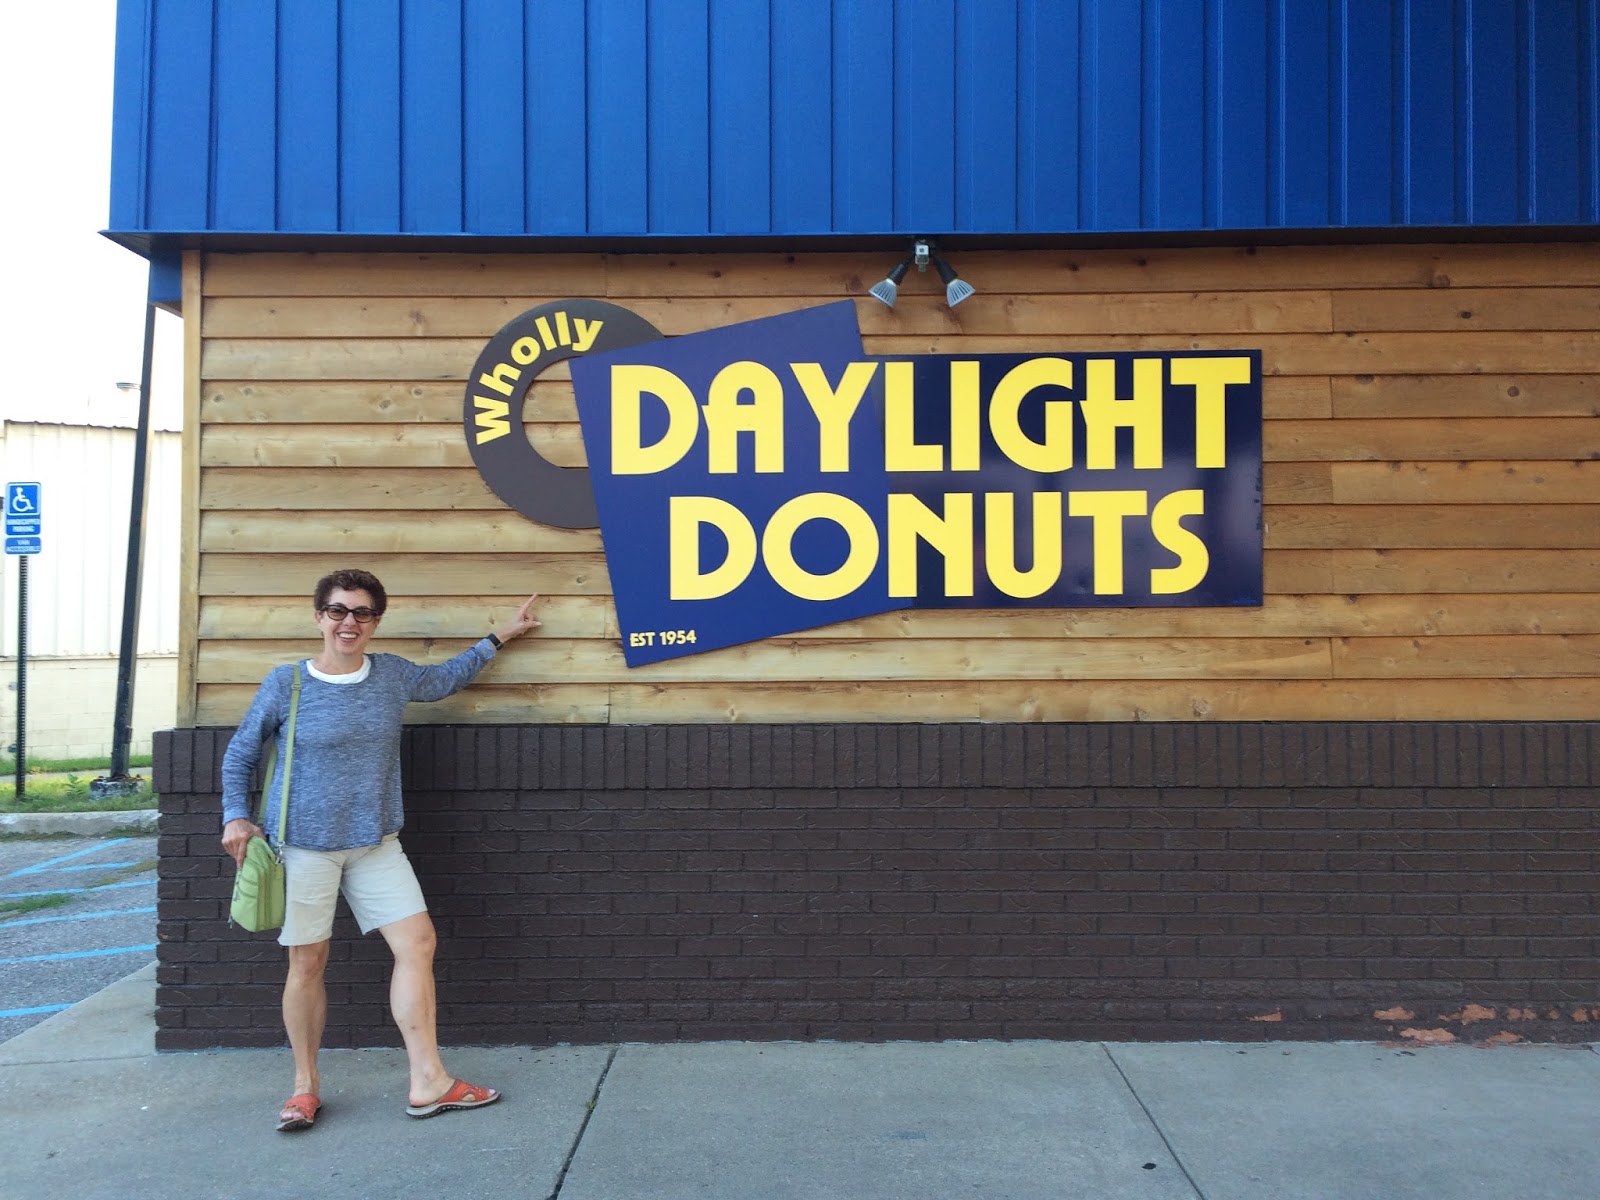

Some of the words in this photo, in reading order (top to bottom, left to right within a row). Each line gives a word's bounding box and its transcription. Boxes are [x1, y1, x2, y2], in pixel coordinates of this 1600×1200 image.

[611, 357, 1251, 475] DAYLIGHT
[670, 490, 1210, 600] DONUTS
[630, 632, 655, 647] EST
[659, 629, 697, 646] 1954
